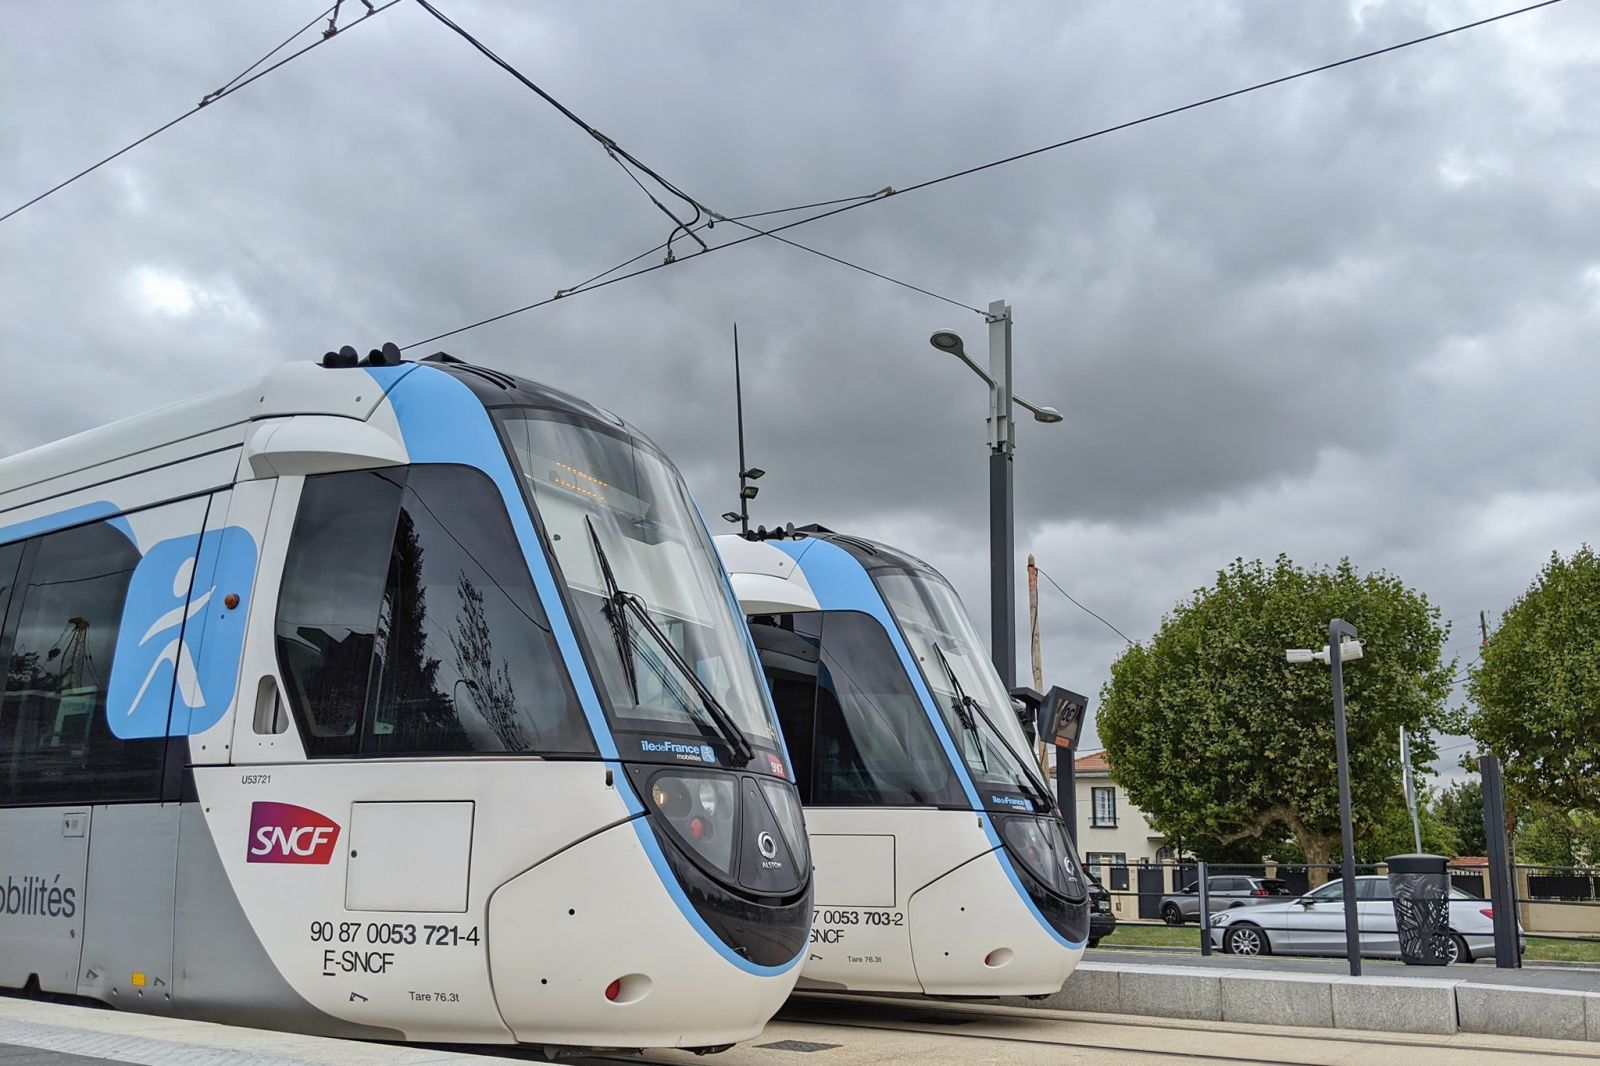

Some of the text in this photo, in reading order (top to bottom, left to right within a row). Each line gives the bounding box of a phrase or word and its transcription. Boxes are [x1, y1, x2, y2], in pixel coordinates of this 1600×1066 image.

[241, 774, 272, 784] U53721
[251, 826, 334, 856] SNCF
[823, 910, 859, 925] 0053
[863, 911, 904, 926] 703-2
[310, 921, 480, 946] 90 87 0053 721-4
[323, 949, 395, 975] F-SNCF
[847, 955, 882, 963] Tare 76.3t
[408, 991, 460, 1002] Tare 76.3t
